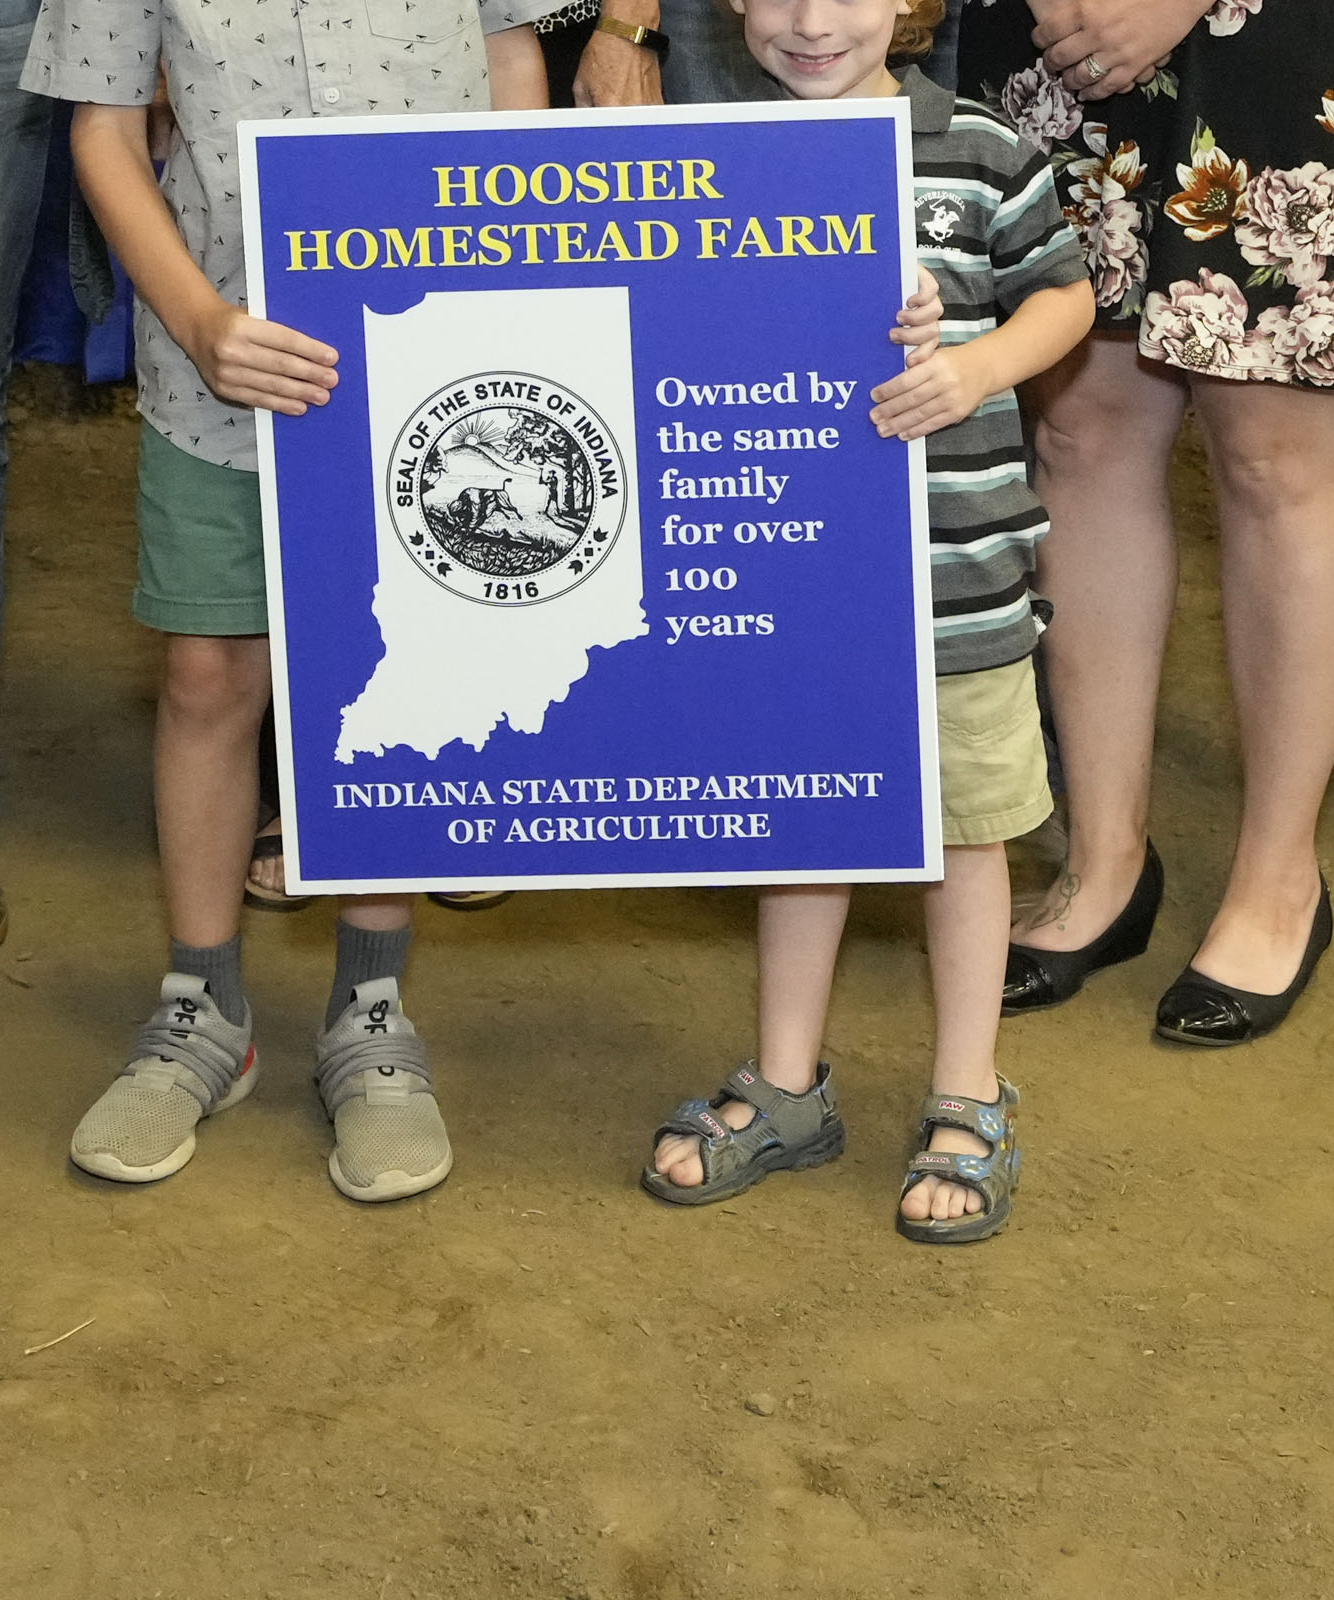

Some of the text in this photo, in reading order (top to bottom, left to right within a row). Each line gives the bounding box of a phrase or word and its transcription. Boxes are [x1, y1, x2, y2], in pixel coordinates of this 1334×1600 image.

[432, 159, 724, 207] HOOSIER
[284, 214, 877, 271] HOMESTEAD FARM
[656, 371, 857, 410] Owned by
[397, 381, 618, 507] SEAL OF THE STATE OF INDIANA
[657, 422, 840, 453] the same
[659, 466, 789, 505] family
[661, 515, 824, 545] for over
[483, 581, 539, 600] 1816
[665, 567, 738, 591] 100
[665, 613, 774, 645] years
[333, 773, 883, 809] INDIANA STATE DEPARTMENT
[447, 813, 771, 844] OF AGRICULTURE
[939, 1101, 964, 1111] PAW
[699, 1112, 725, 1138] PATROL
